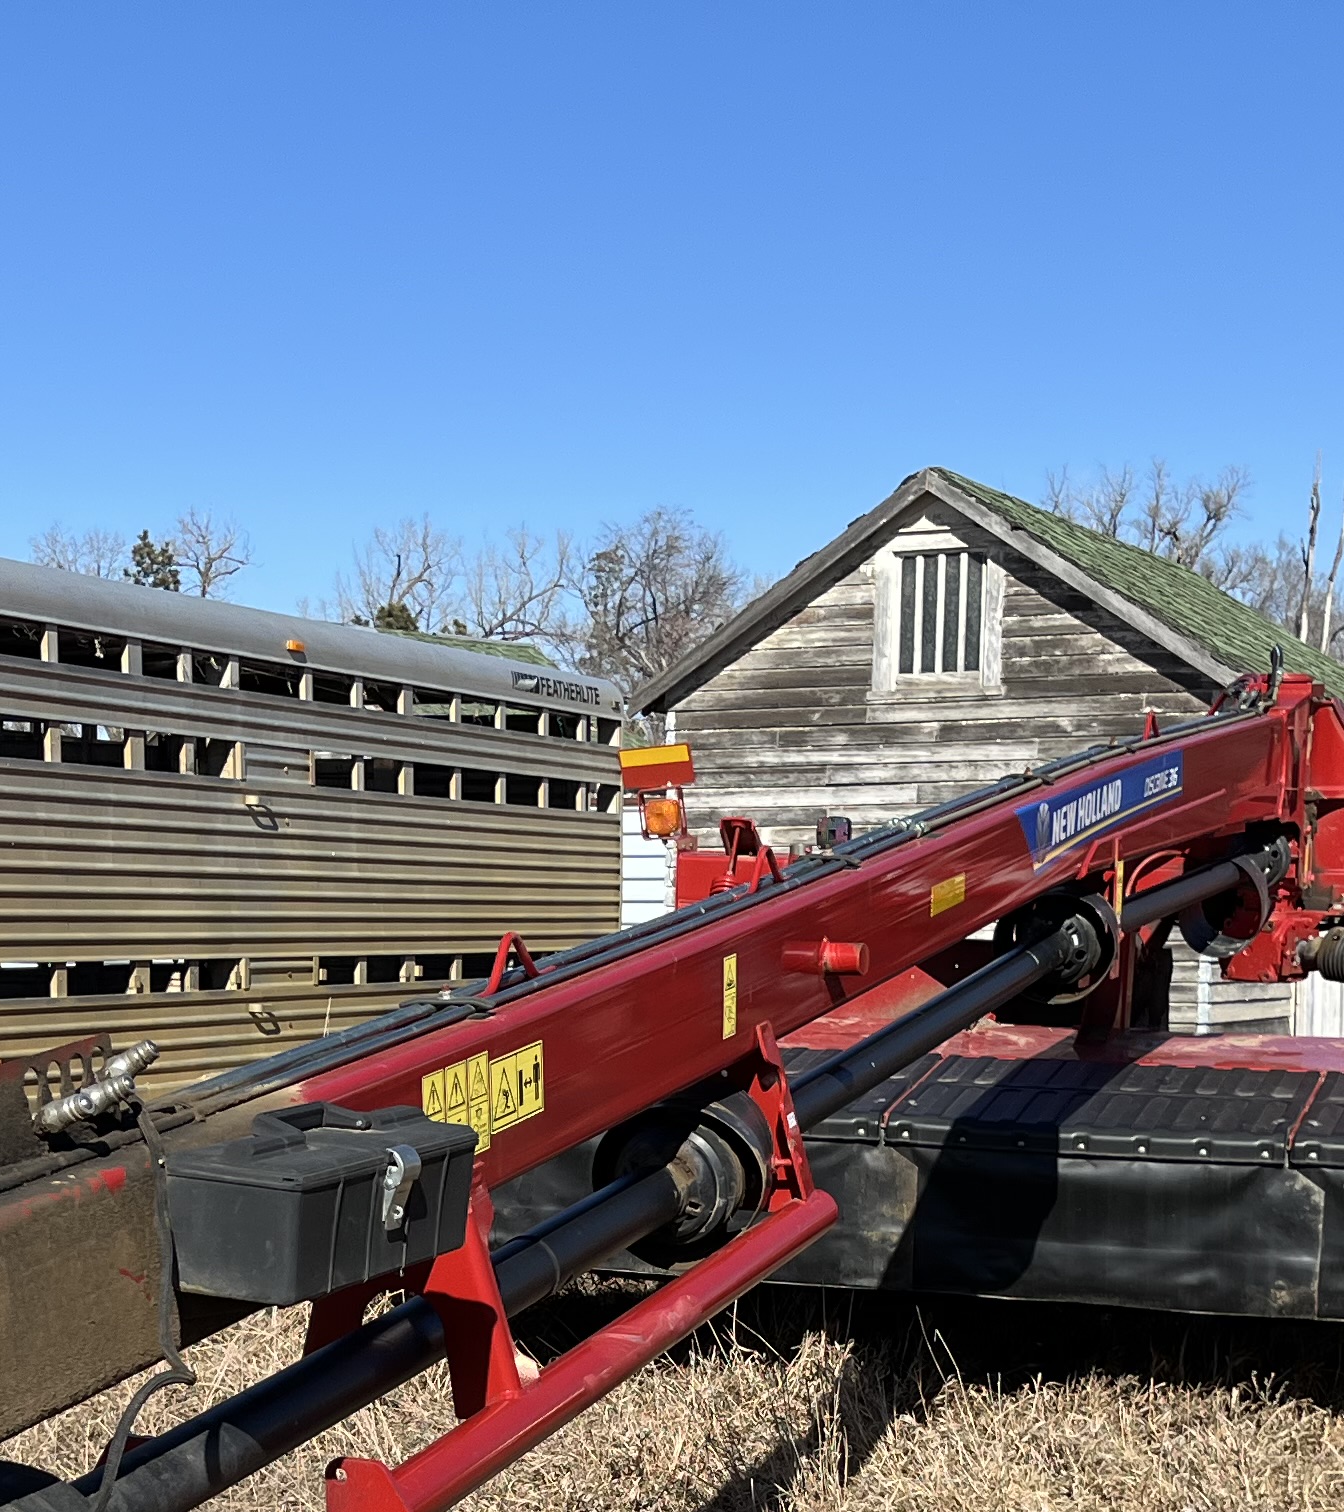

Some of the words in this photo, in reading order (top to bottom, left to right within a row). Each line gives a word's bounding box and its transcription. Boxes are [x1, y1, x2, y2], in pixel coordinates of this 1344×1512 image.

[540, 677, 601, 705] FEATHERLITE
[1052, 800, 1077, 846] NEW
[1077, 779, 1122, 832] HOLLAND
